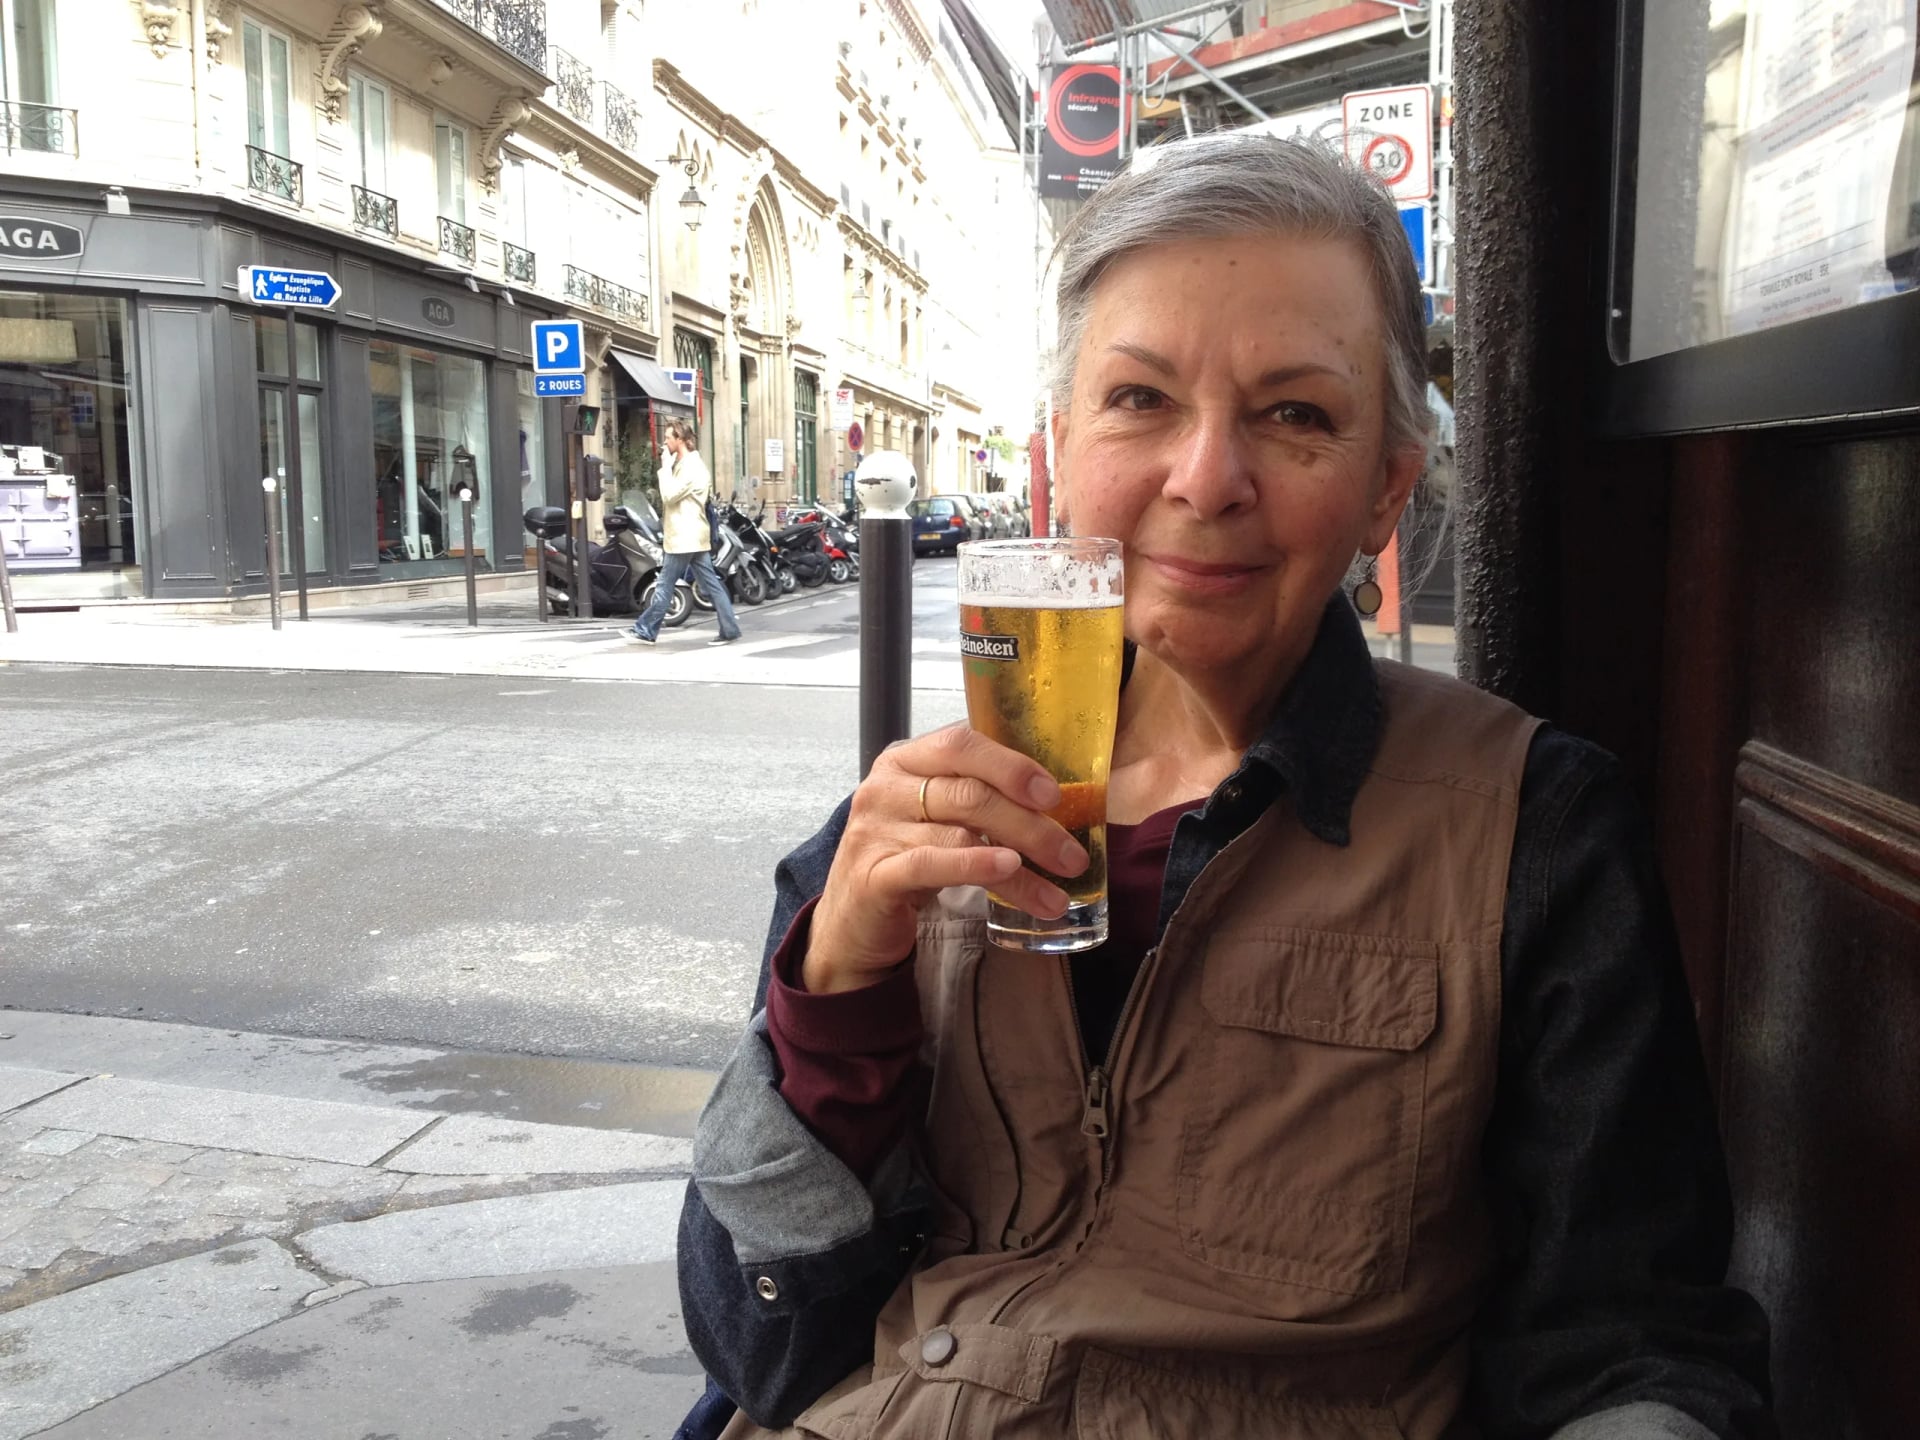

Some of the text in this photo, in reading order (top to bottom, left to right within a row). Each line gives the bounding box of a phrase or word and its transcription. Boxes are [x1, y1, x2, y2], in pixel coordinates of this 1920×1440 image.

[1067, 104, 1098, 112] sécurité
[1068, 92, 1120, 108] Infraroug
[1360, 102, 1413, 123] ZONE
[1374, 151, 1402, 169] 30
[284, 284, 311, 293] Baptiste
[309, 295, 322, 303] Lille
[429, 302, 450, 322] AGA
[546, 330, 569, 363] P
[539, 379, 582, 391] 2 ROUES
